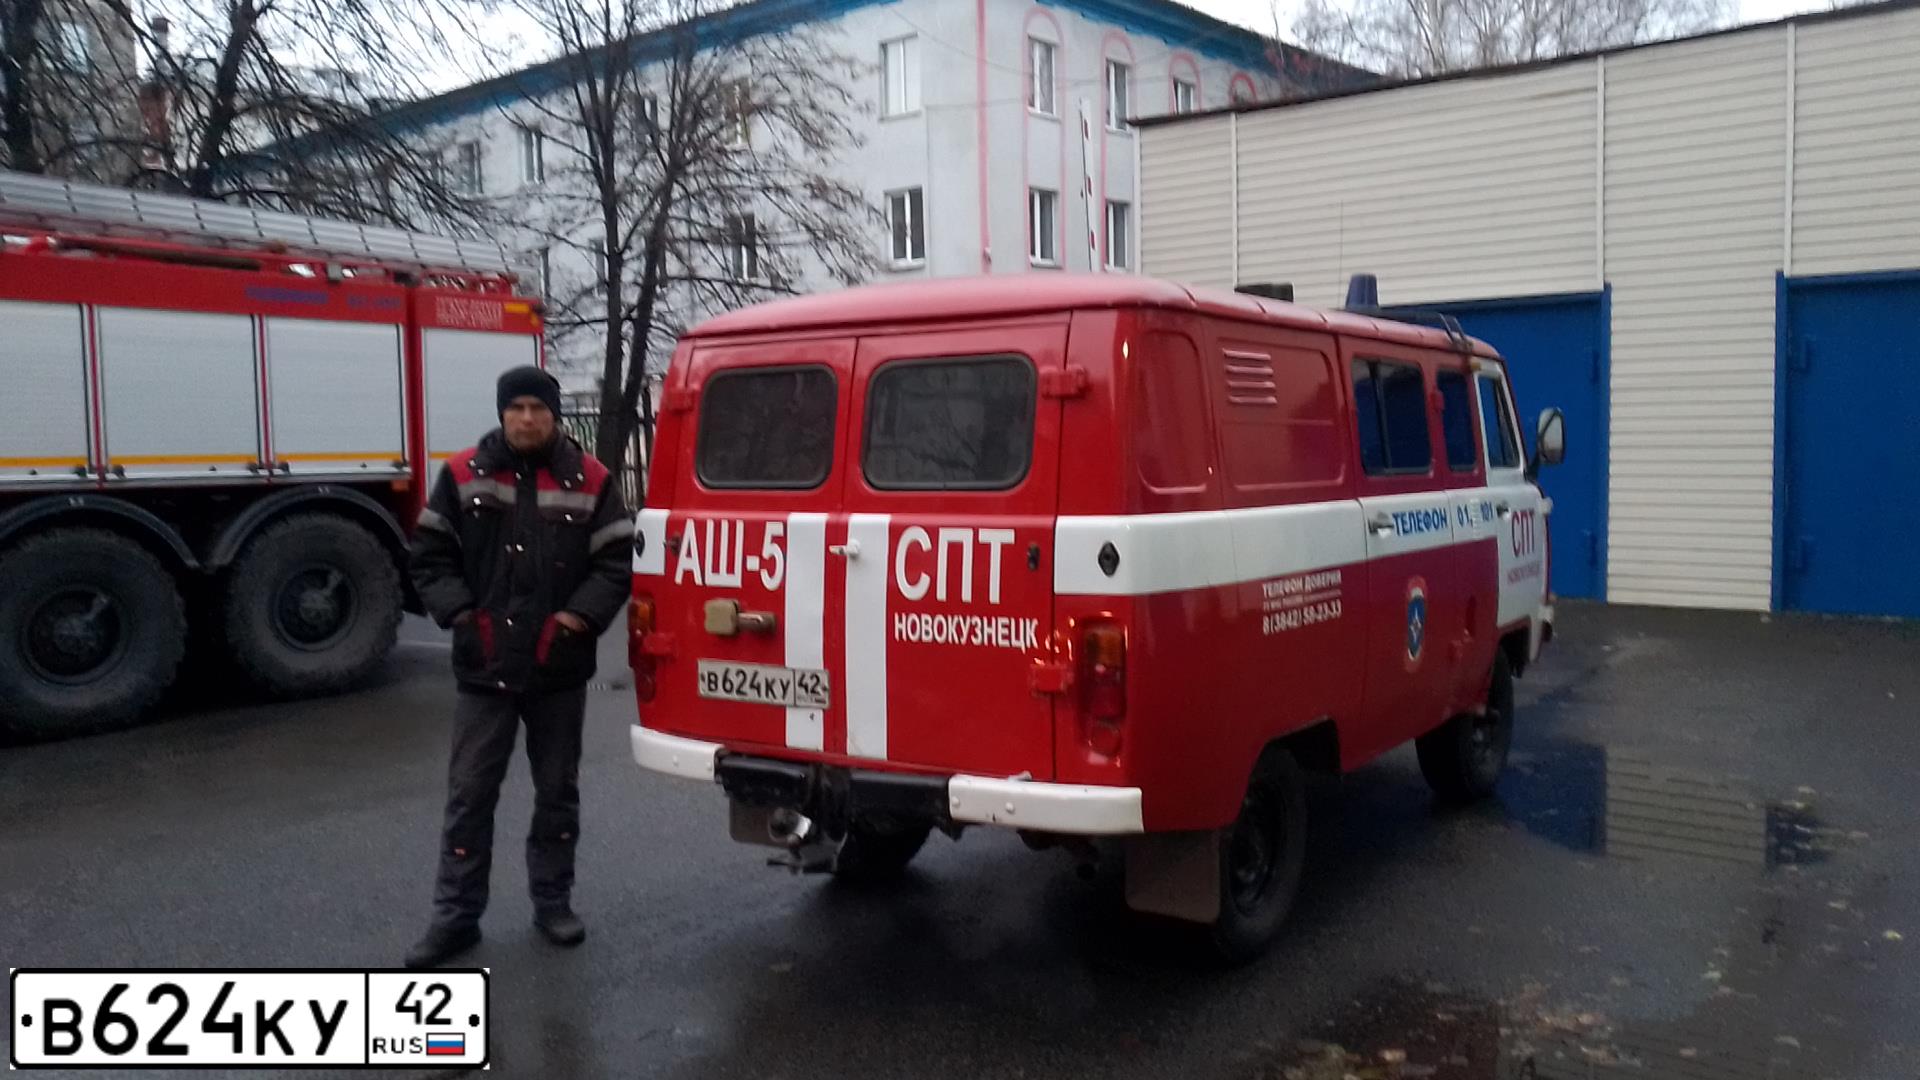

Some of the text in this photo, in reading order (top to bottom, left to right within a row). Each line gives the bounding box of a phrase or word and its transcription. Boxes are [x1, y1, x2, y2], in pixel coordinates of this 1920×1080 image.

[1392, 508, 1448, 536] ТЕЛЕФОН
[1511, 507, 1535, 558] СПТ
[674, 518, 784, 591] АШ-5
[895, 525, 1015, 604] СПТ
[1263, 577, 1303, 599] ТЕЛЕФОН
[894, 612, 1039, 654] НОВОКУЗНЕЦК
[707, 667, 821, 700] В624КУ 42
